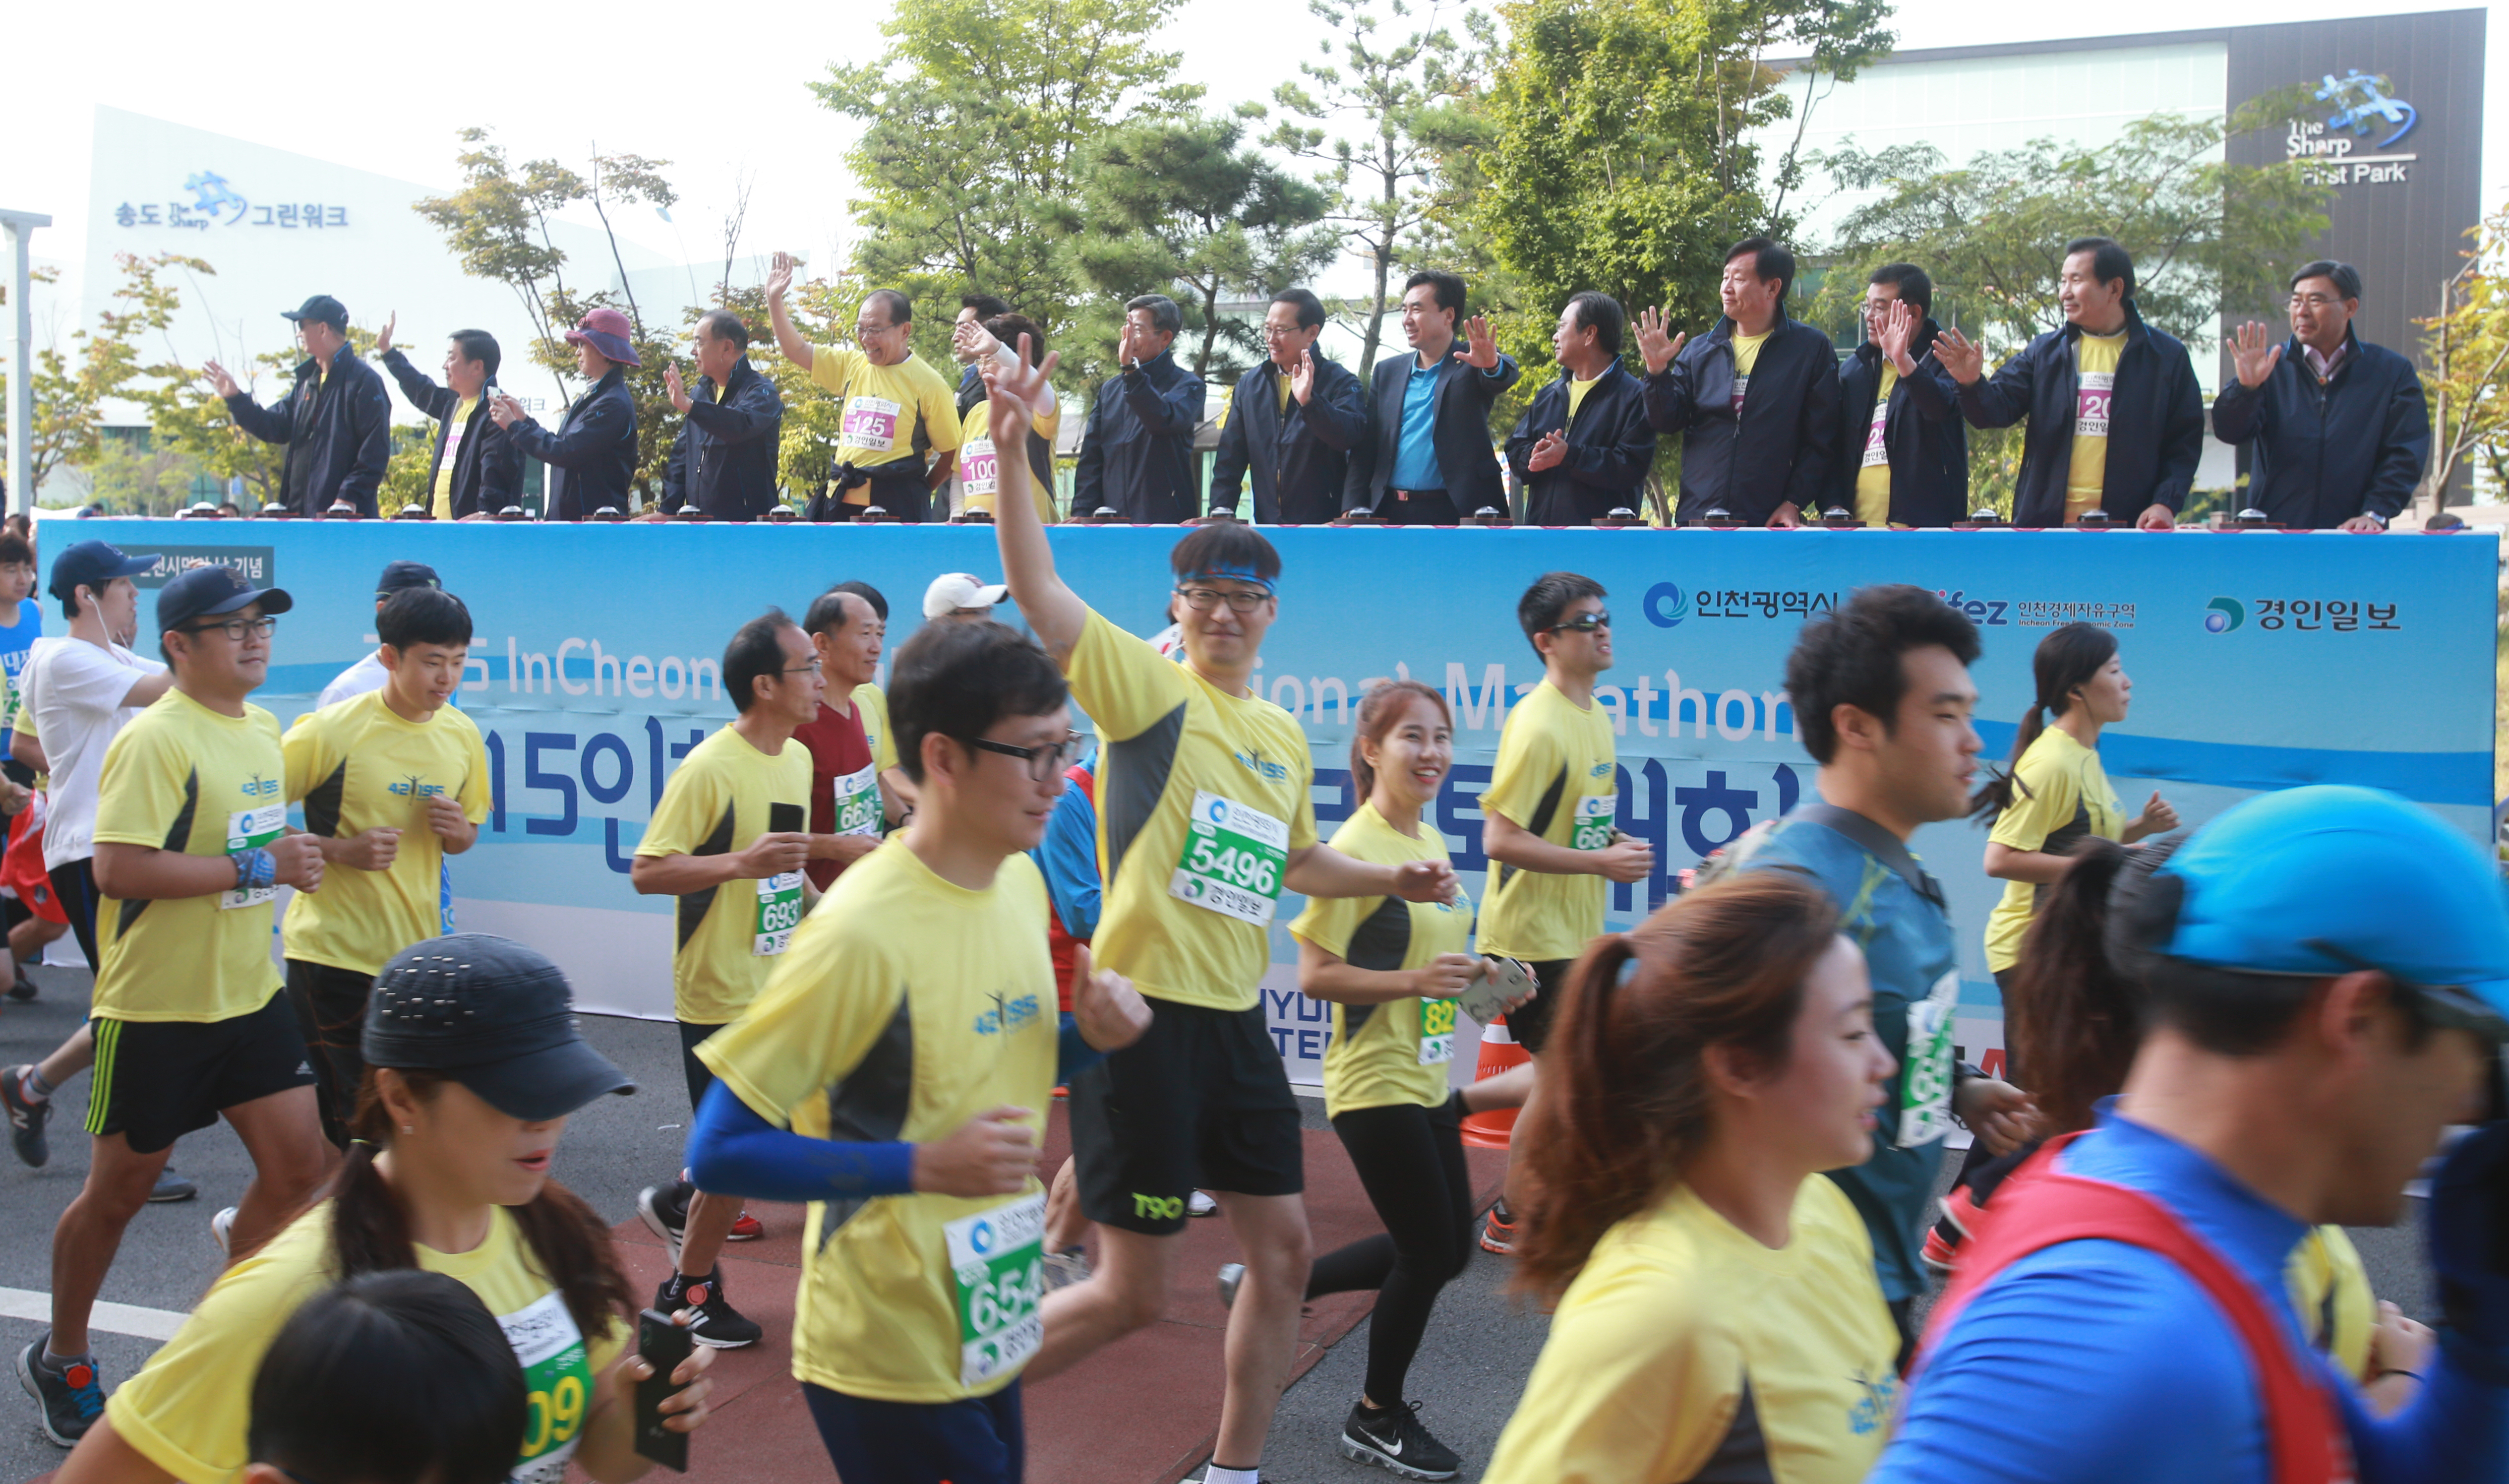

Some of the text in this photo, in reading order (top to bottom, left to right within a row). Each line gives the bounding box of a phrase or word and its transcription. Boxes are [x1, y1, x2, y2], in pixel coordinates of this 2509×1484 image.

[2287, 136, 2351, 158] Sharp
[2354, 163, 2406, 183] Park
[115, 202, 161, 227] 송도
[169, 214, 209, 230] Sharp
[252, 204, 349, 228] 그린워크
[519, 396, 547, 413] 워크
[853, 415, 886, 436] 125
[855, 435, 885, 448] 경인일보
[968, 459, 997, 480] 100
[234, 556, 262, 579] 기념
[1696, 589, 1838, 619] 인천광역시
[1938, 589, 2008, 626] fez
[2018, 601, 2135, 619] 인천경제자유구역
[2255, 598, 2402, 632] 경인일보
[508, 636, 721, 701] InCheon
[1446, 662, 1801, 743] Mathon
[1188, 836, 1277, 895] 5496
[762, 896, 802, 932] 693
